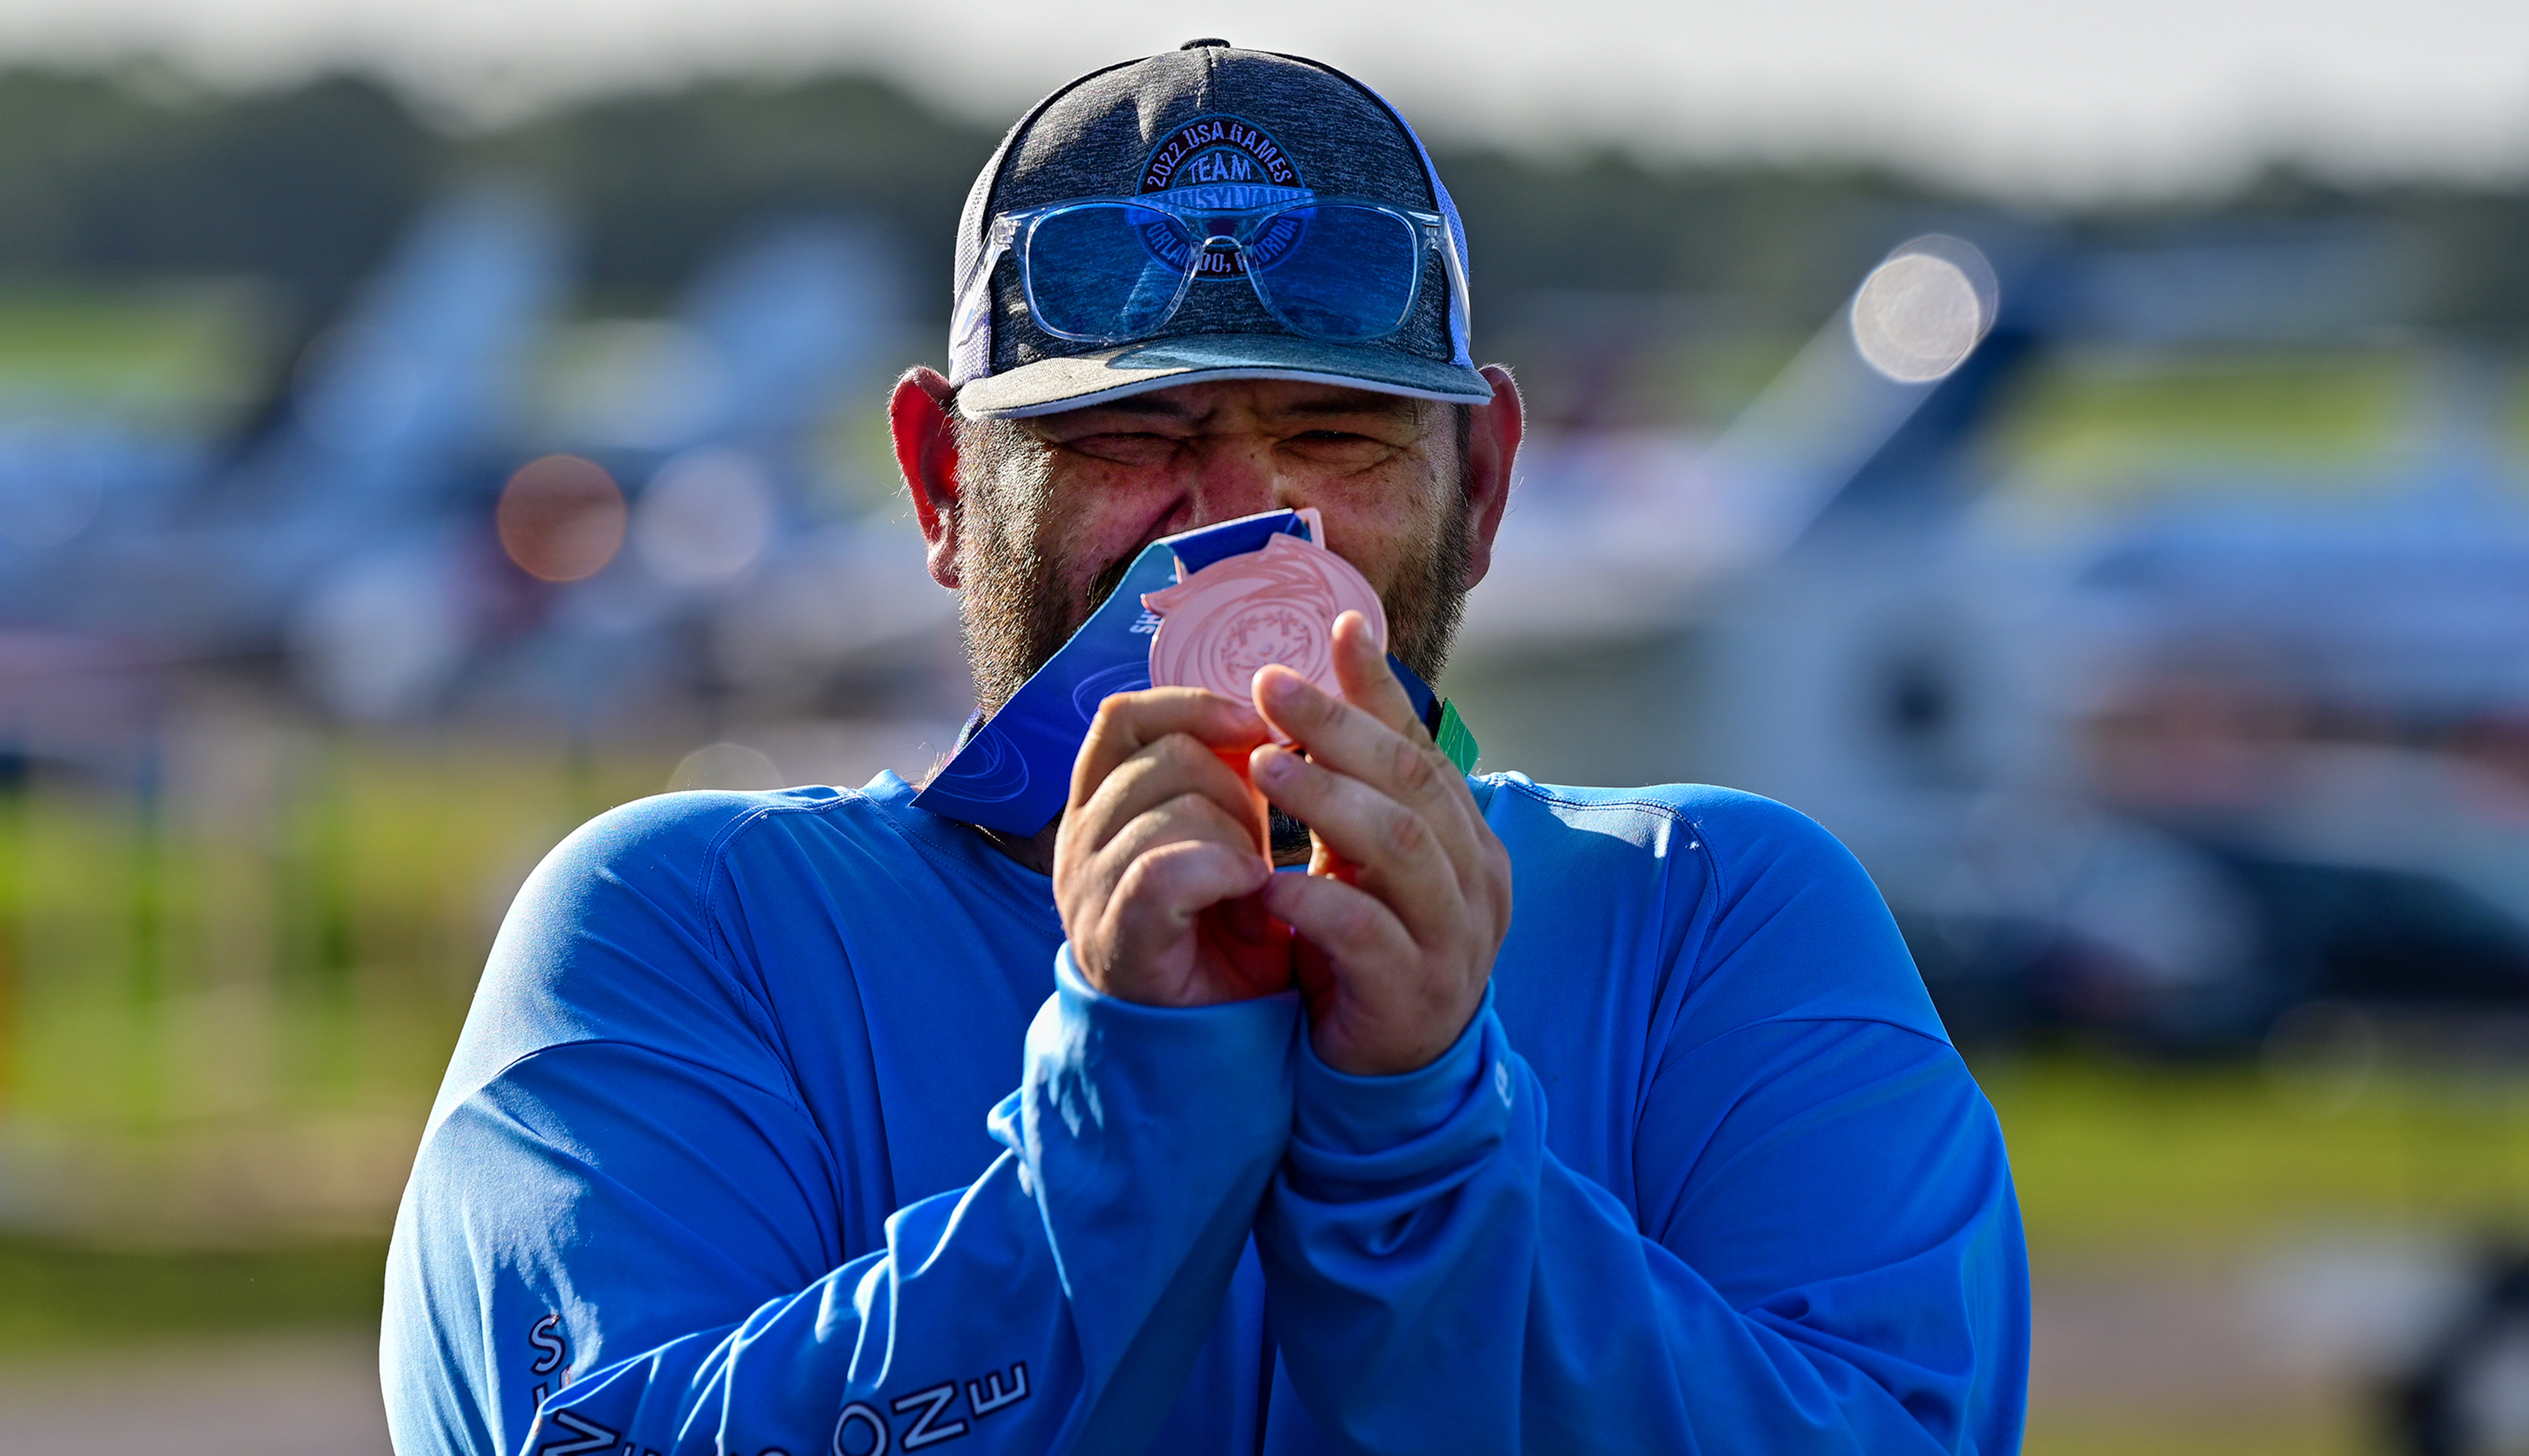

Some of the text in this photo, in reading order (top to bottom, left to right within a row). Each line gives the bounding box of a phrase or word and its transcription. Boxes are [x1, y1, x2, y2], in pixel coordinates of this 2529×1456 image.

[1146, 121, 1292, 188] 2022 USA GAMES
[1187, 152, 1252, 183] TEAM
[1234, 217, 1299, 272] FORIDA
